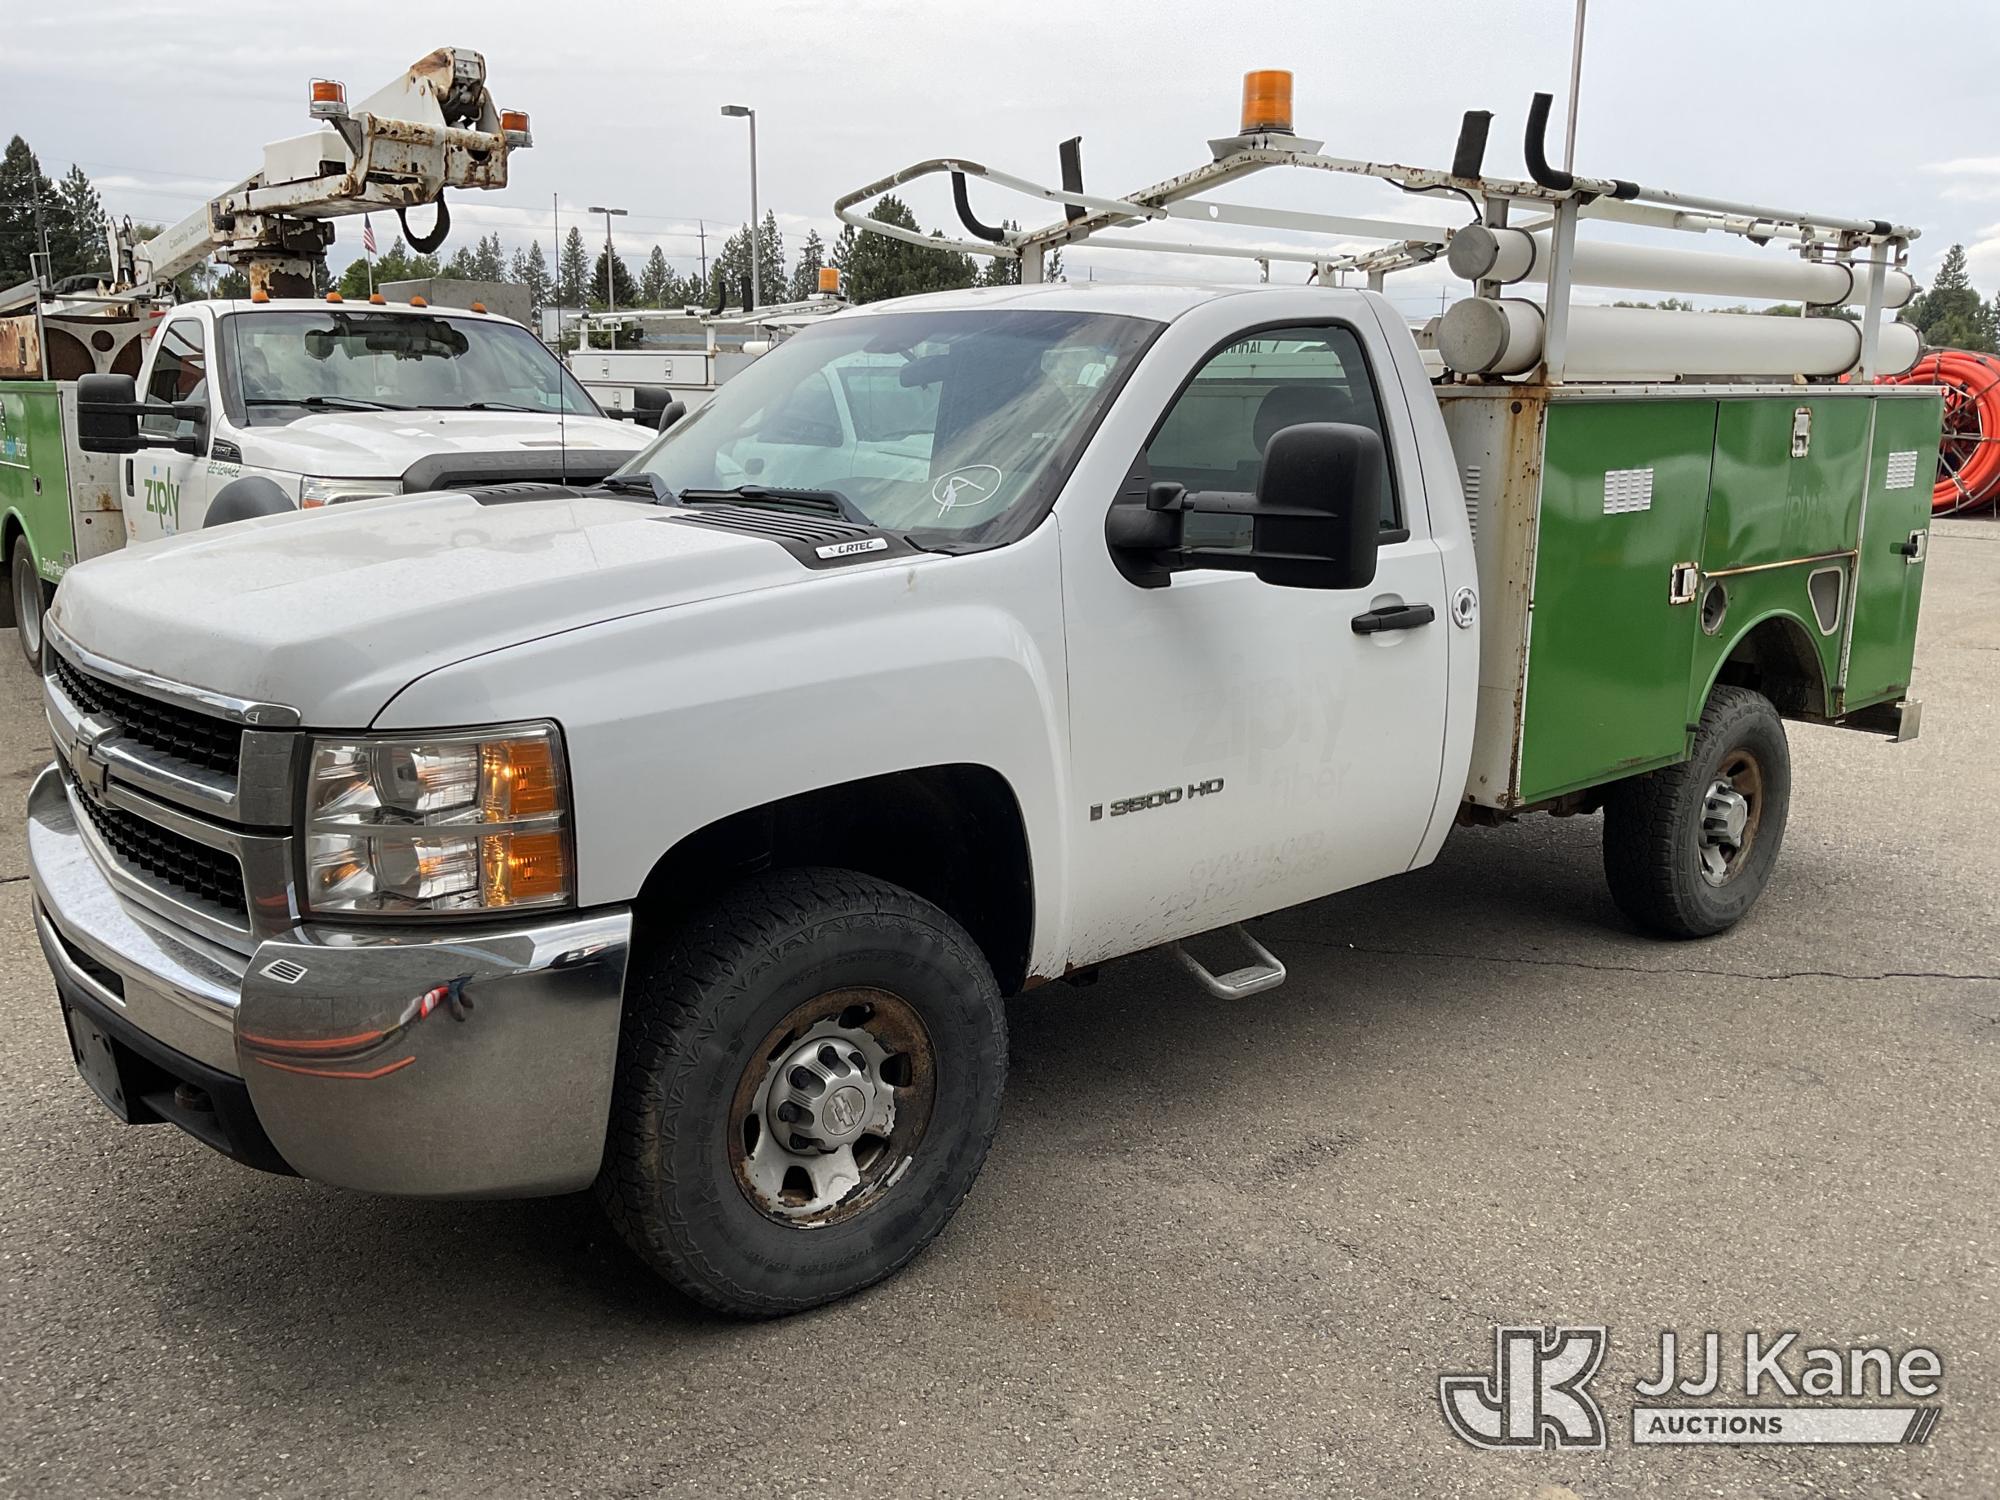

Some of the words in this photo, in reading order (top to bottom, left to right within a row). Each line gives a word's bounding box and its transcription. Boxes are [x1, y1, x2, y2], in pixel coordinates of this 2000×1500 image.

[143, 465, 180, 531] ziply
[1110, 786, 1183, 817] 3500
[1187, 777, 1224, 799] HD
